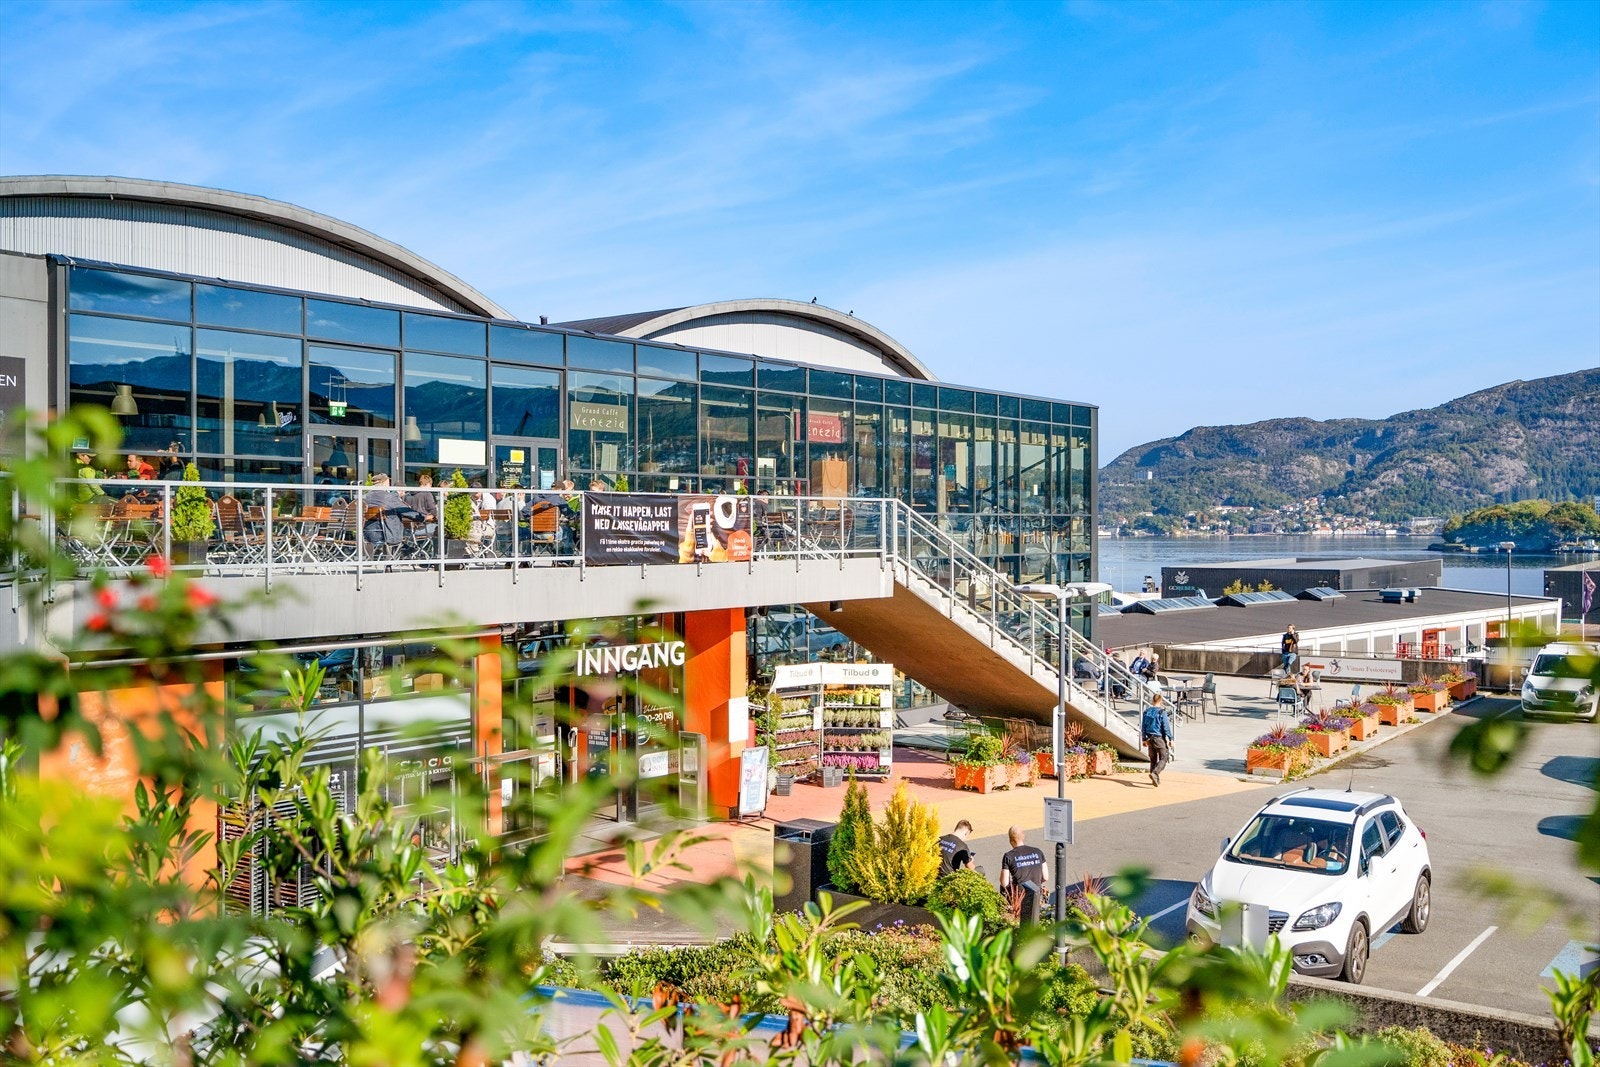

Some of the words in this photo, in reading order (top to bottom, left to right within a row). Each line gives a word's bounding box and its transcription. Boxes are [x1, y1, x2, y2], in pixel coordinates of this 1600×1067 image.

[574, 413, 624, 429] Venezia
[808, 426, 840, 439] enezia
[592, 504, 611, 516] MAKE
[613, 506, 621, 516] IT
[623, 506, 653, 518] HAPPEN,
[654, 507, 672, 517] LAST
[595, 519, 610, 530] NED
[577, 641, 685, 676] INNGANG
